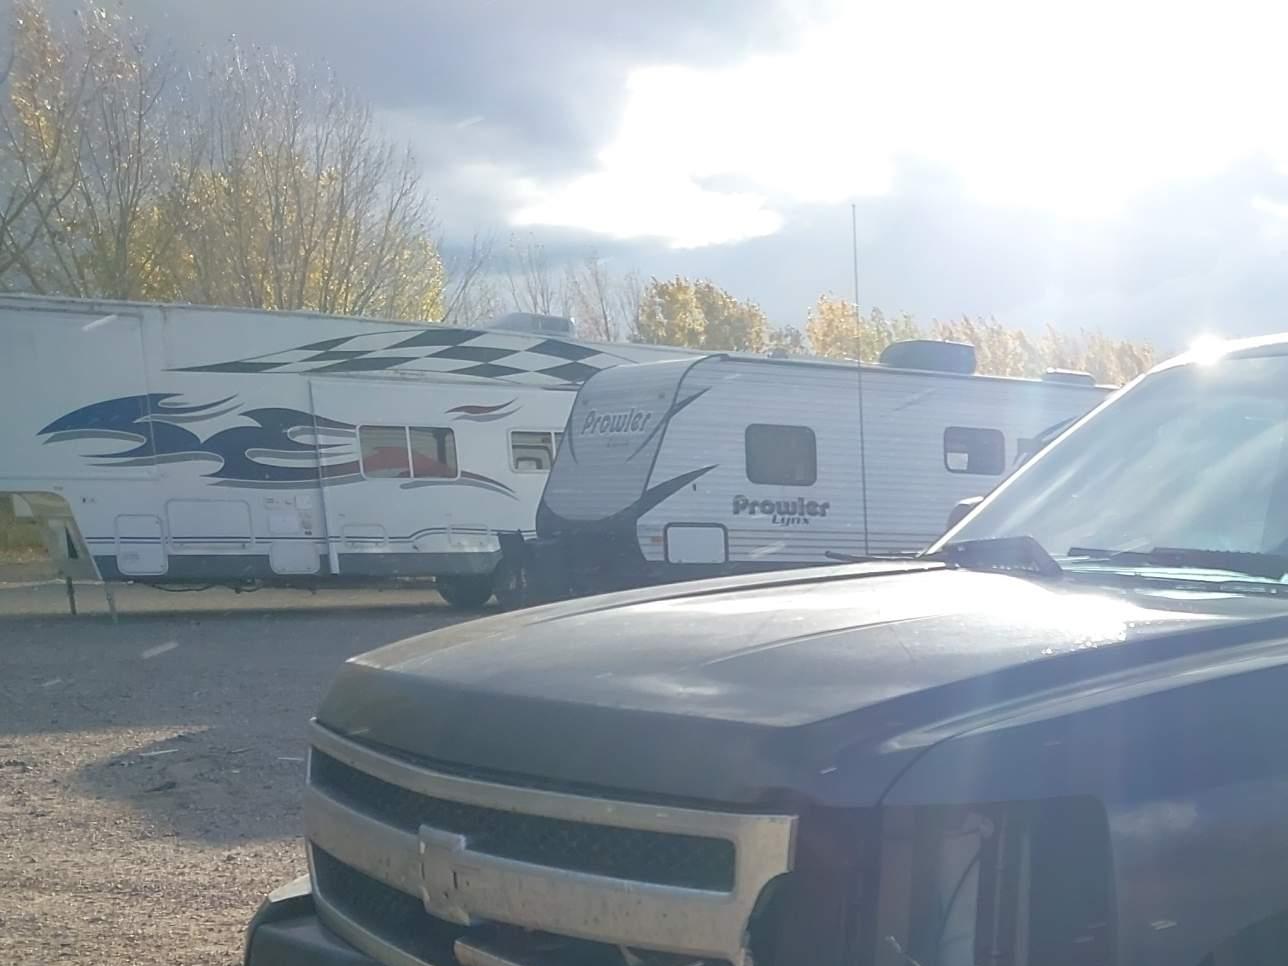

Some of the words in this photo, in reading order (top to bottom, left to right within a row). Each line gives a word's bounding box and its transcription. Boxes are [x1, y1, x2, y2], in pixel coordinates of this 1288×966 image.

[580, 408, 654, 434] Prowler
[732, 494, 830, 517] Prowler
[771, 514, 810, 527] Lynx
